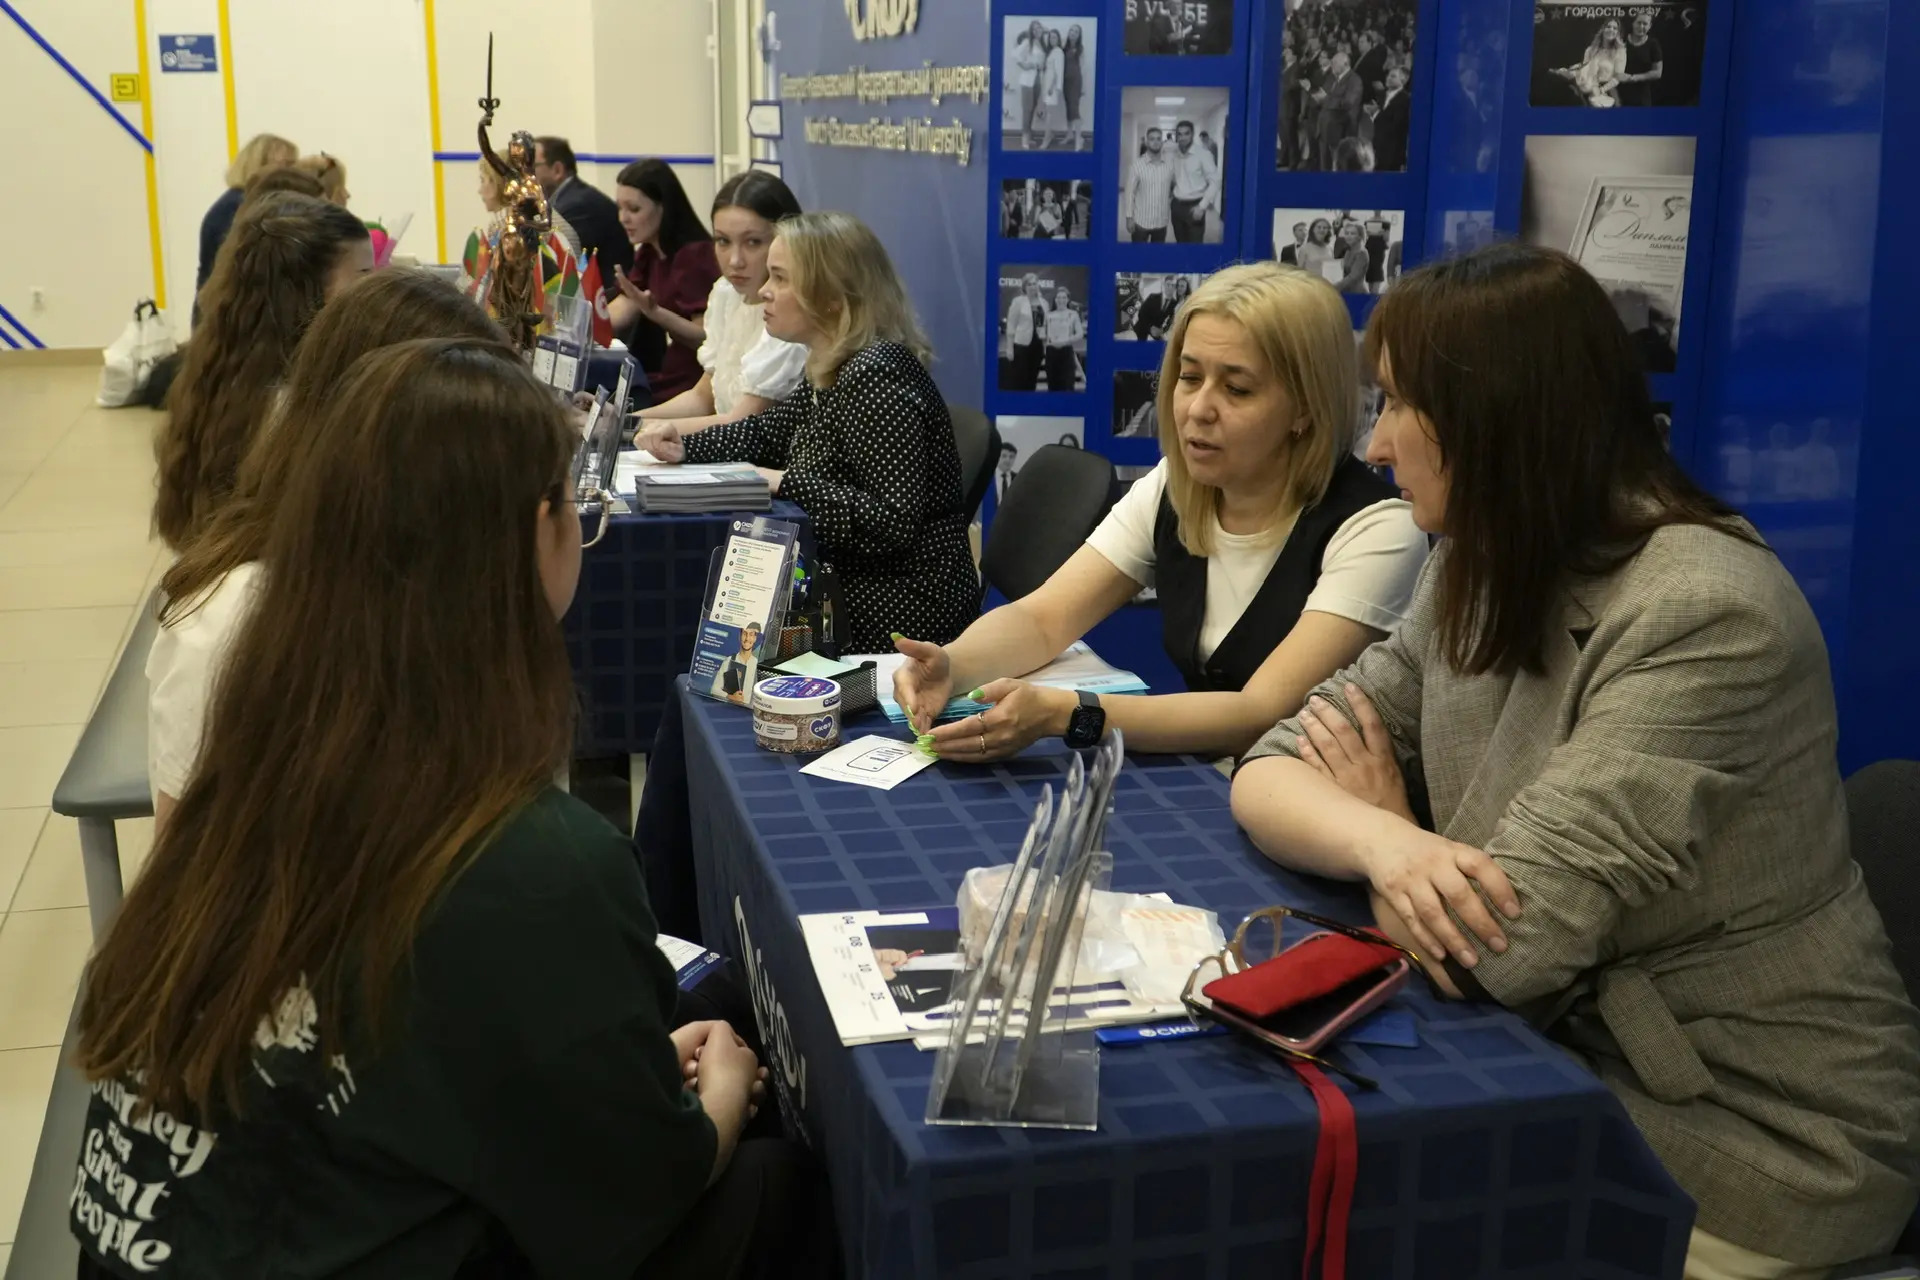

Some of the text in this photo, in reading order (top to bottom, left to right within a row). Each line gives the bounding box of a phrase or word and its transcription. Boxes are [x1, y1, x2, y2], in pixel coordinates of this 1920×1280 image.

[1564, 6, 1625, 19] ГОРДОСТЬ
[907, 116, 972, 166] University
[814, 722, 832, 733] СКФУ
[842, 915, 856, 925] 04
[849, 936, 863, 947] 08
[858, 963, 872, 973] 10
[84, 1127, 171, 1221] Great
[70, 1165, 172, 1273] People
